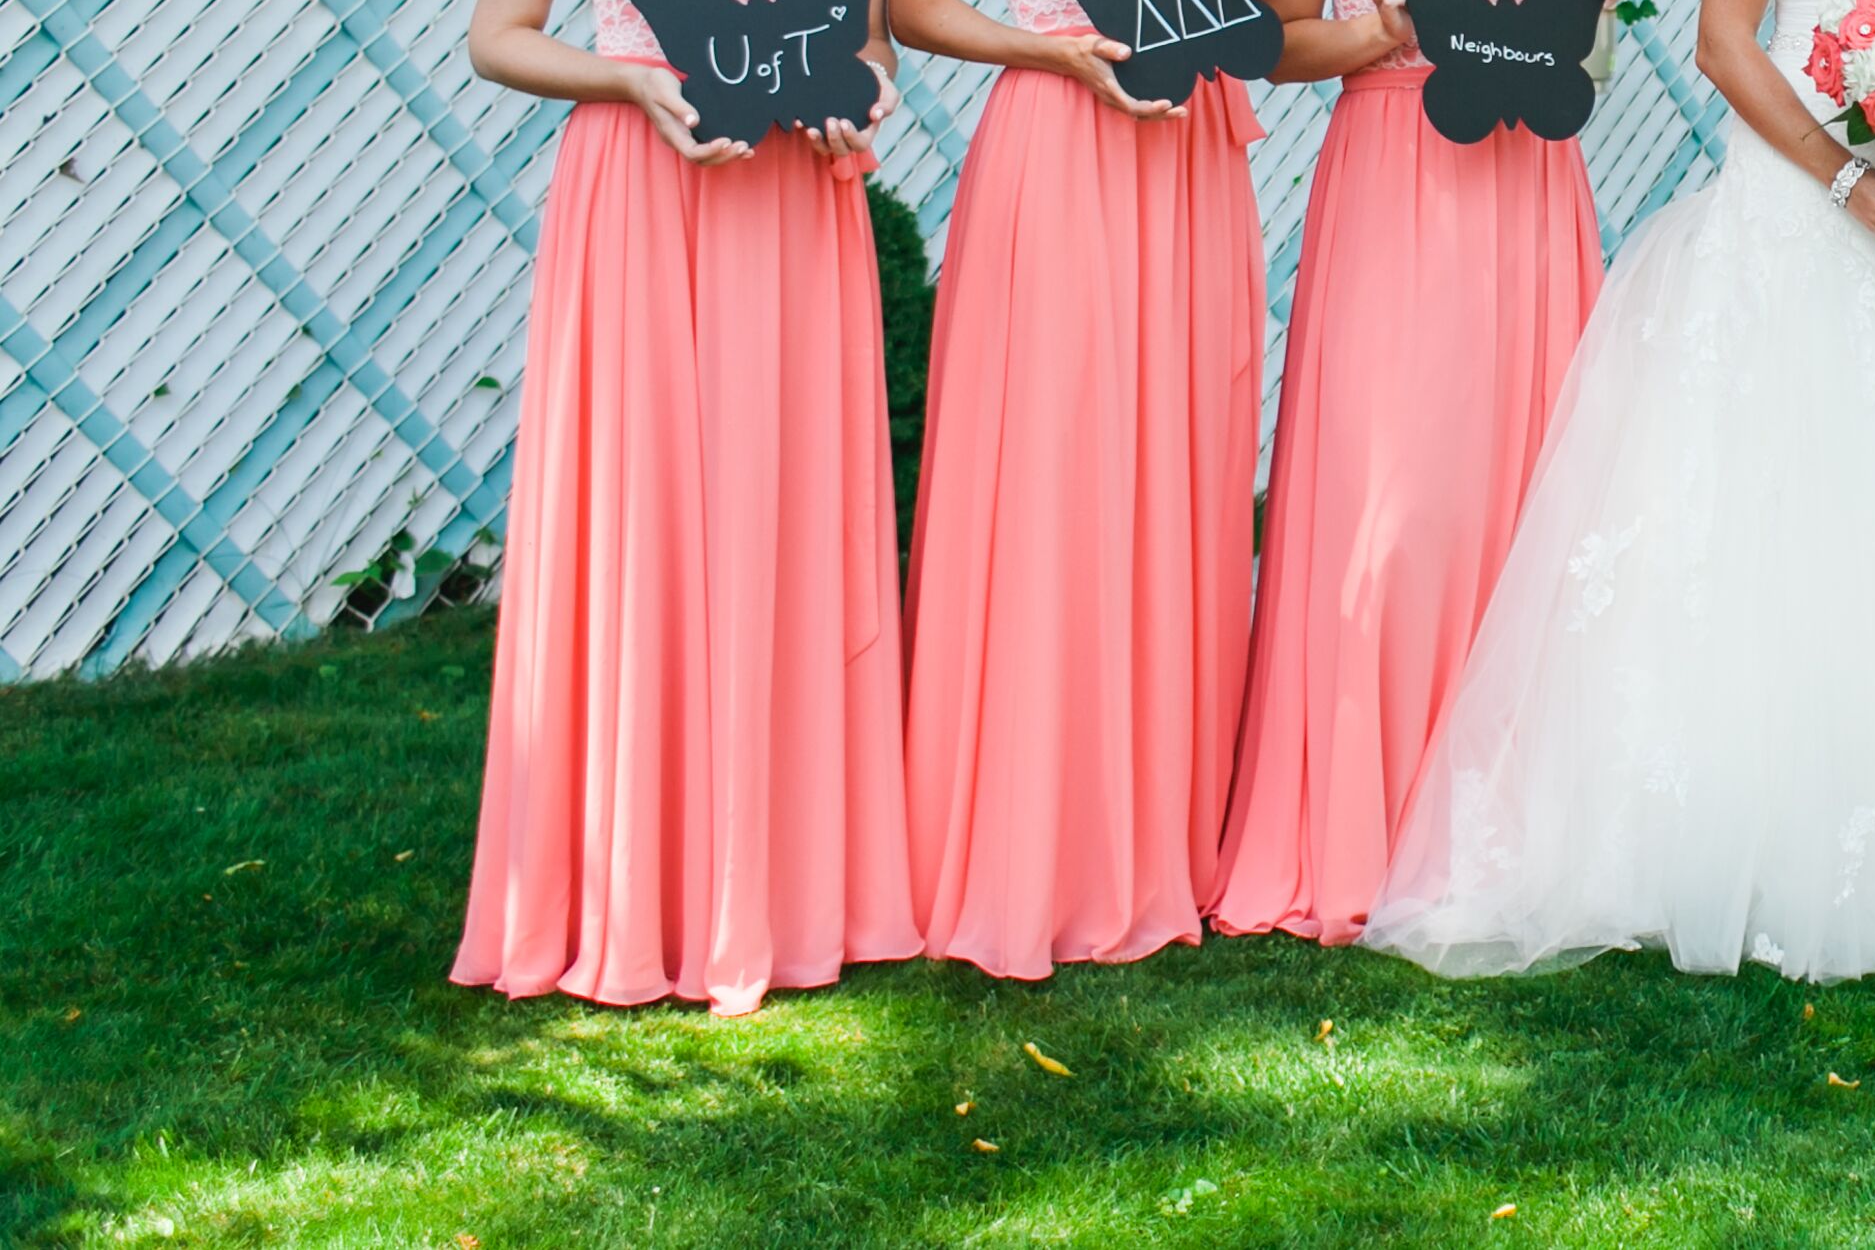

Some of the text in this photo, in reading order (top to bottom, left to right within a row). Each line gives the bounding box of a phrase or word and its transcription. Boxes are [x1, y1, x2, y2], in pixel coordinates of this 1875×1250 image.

[709, 23, 831, 95] U of T
[1449, 32, 1556, 67] Neighbours
